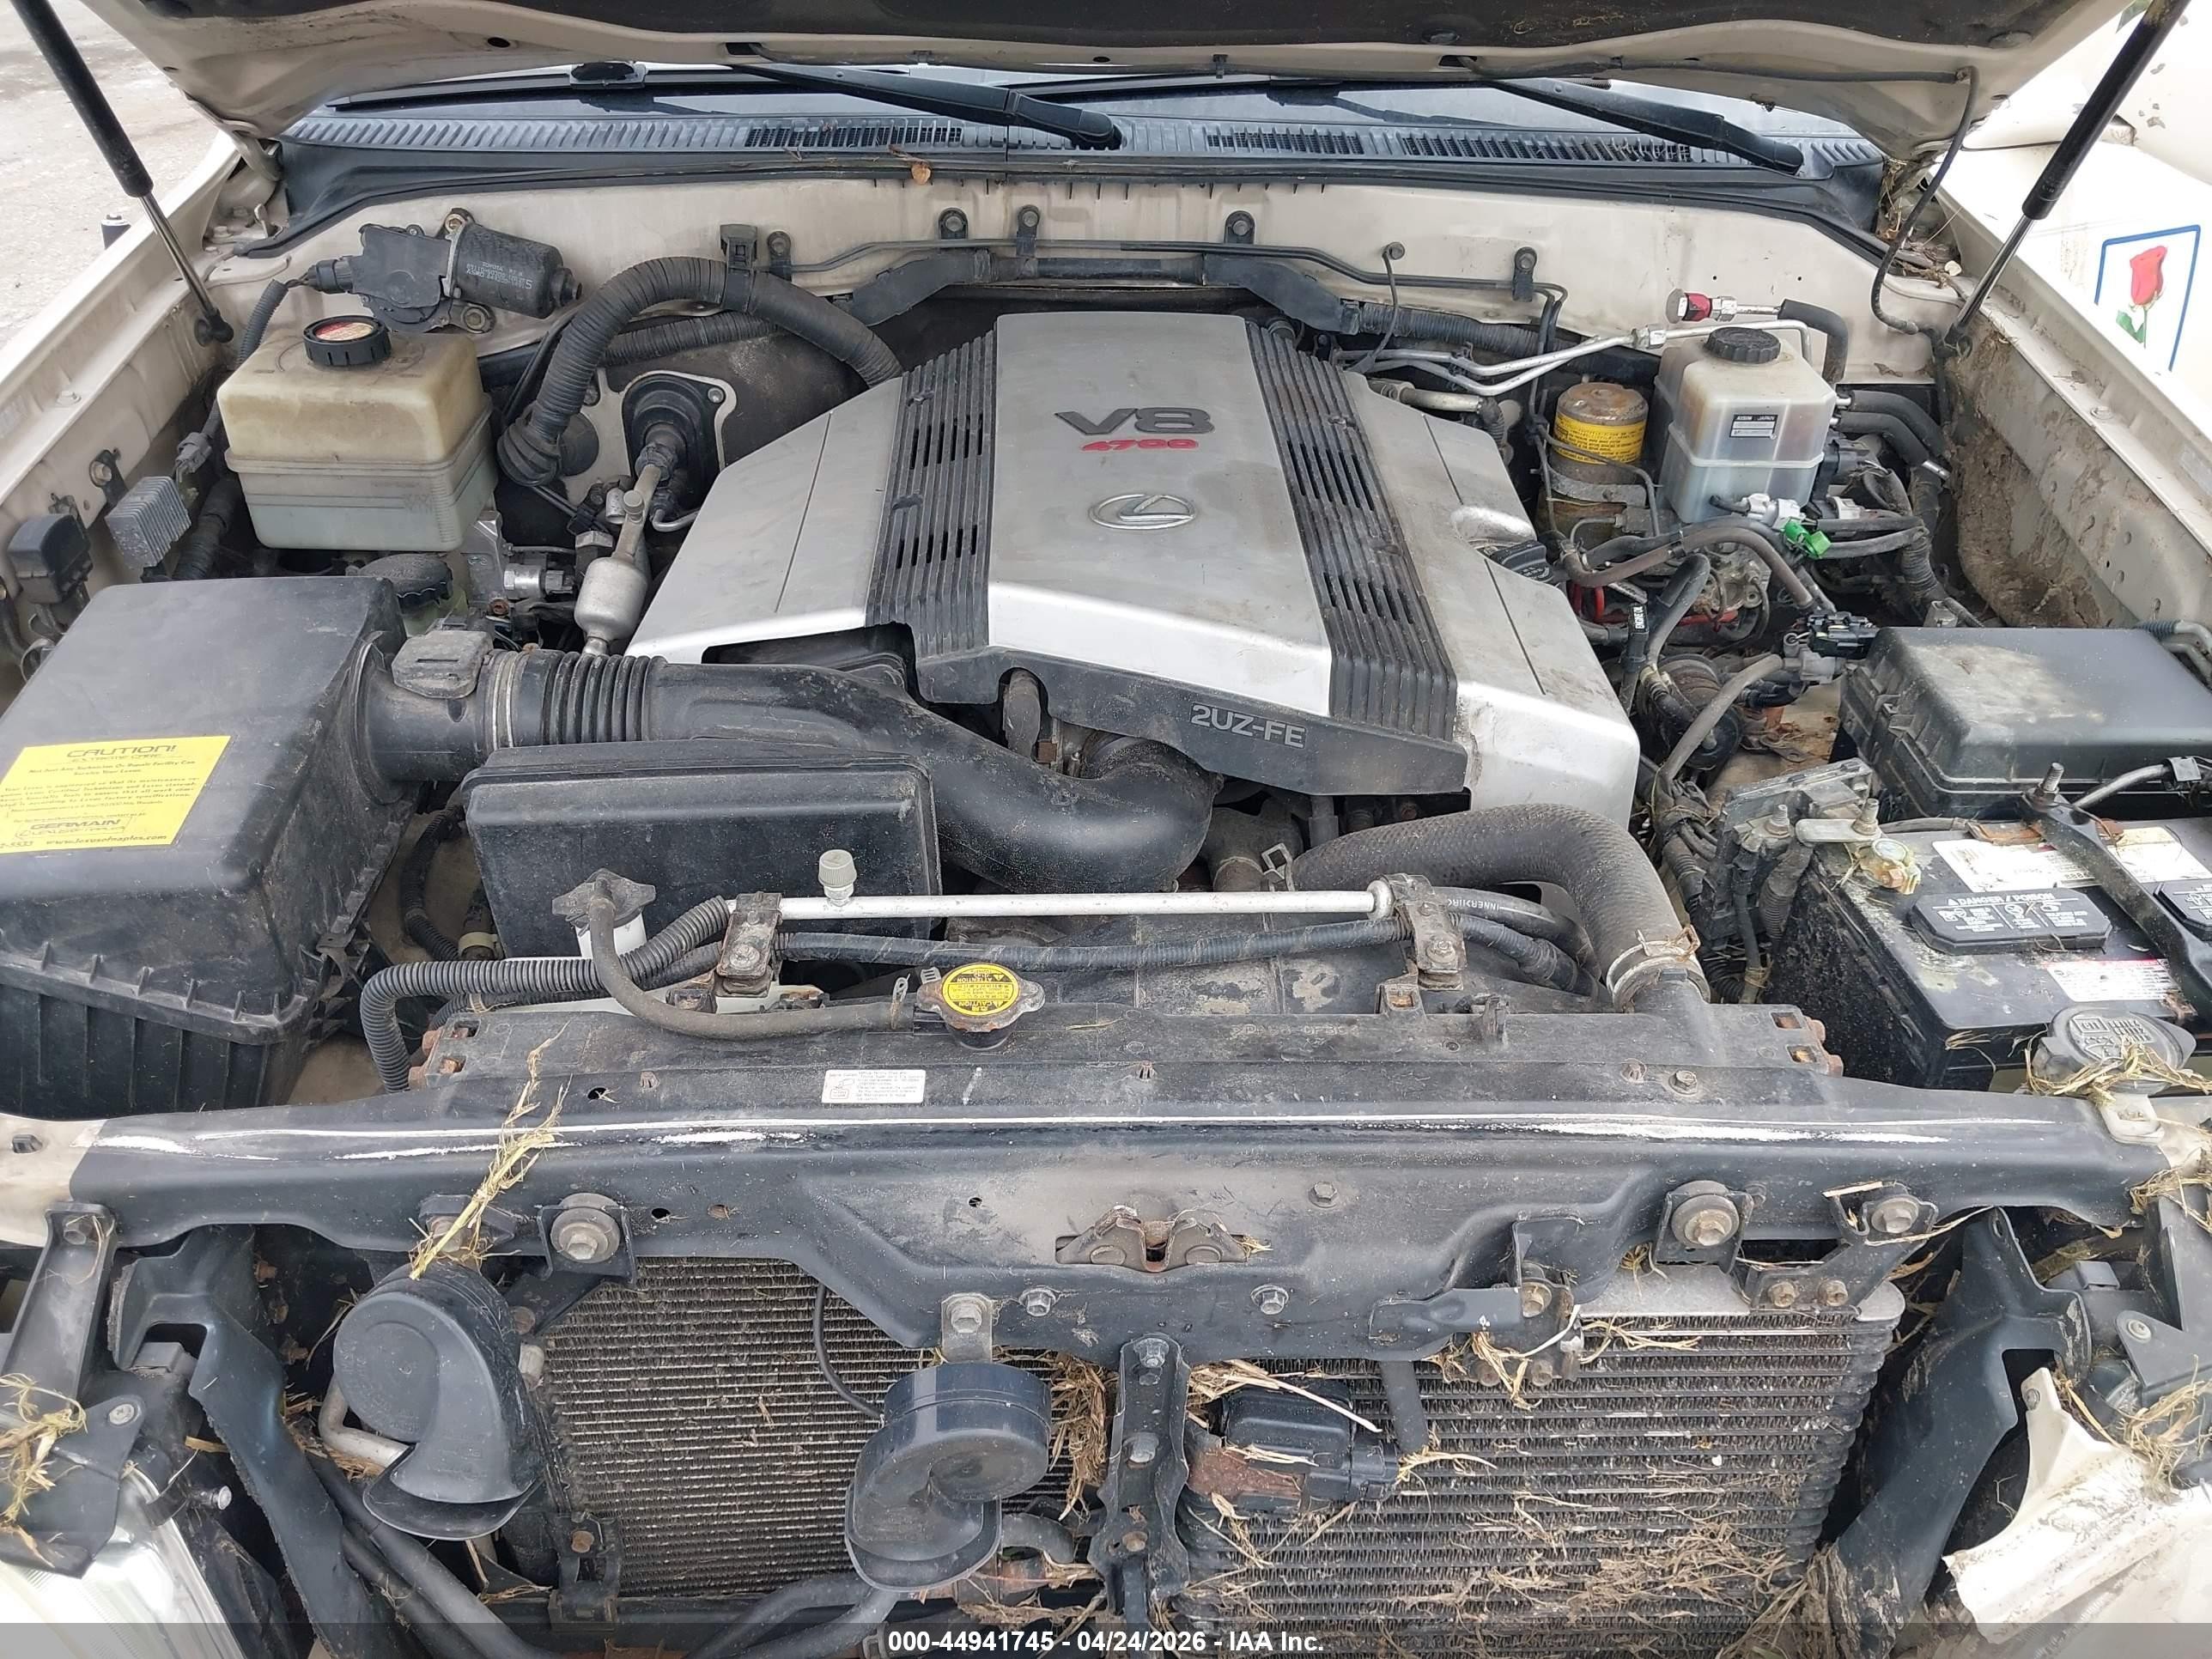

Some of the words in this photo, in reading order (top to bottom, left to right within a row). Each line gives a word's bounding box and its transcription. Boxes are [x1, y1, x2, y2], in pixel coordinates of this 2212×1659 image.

[1054, 407, 1215, 435] V8
[1191, 704, 1305, 749] 2UZ-FE
[67, 744, 177, 758] CAUTION!
[31, 818, 121, 830] GERMAIN
[1959, 896, 2004, 906] DANGER
